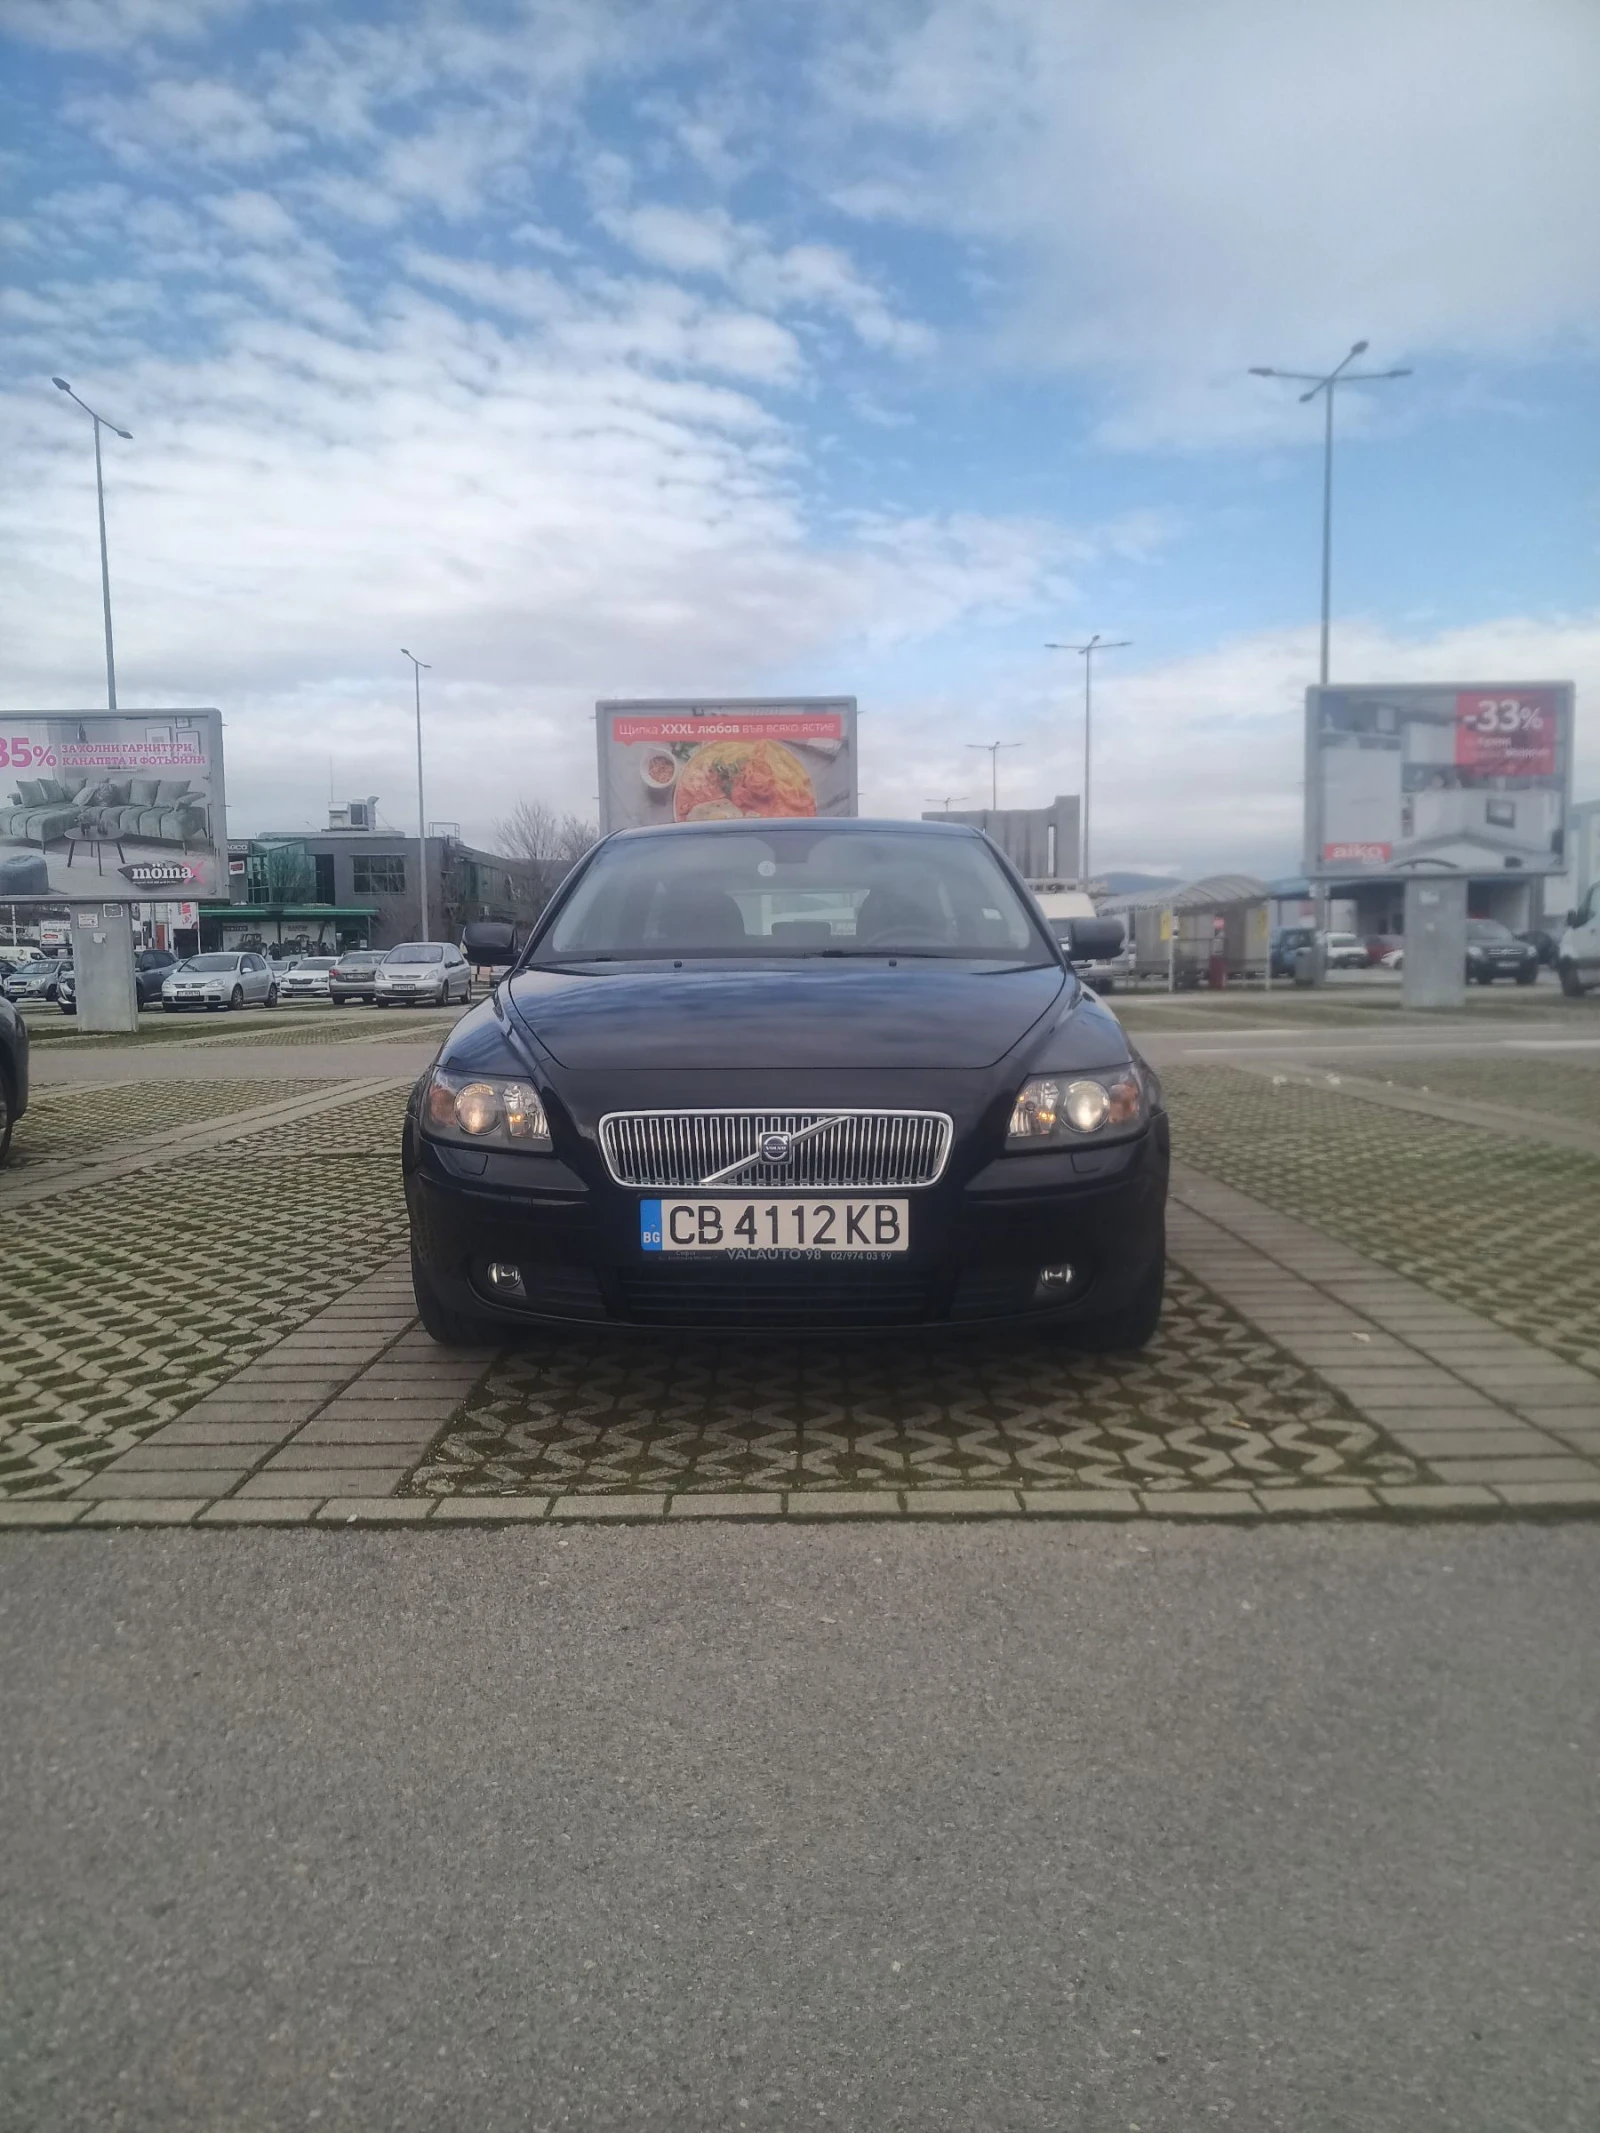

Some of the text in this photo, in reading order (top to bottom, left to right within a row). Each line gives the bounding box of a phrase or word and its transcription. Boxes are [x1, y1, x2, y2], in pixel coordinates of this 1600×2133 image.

[1463, 698, 1544, 731] -33%
[619, 722, 835, 737] Щипка XXXL любов във всяко ястие
[61, 744, 76, 753] ЗА
[77, 744, 119, 753] ХОЛНИ
[62, 755, 206, 766] КАНАПЕТА И ФОТЬОЙЛИ
[643, 1232, 661, 1243] BG
[725, 1247, 802, 1261] VALAUTO
[805, 1247, 822, 1260] 98
[830, 1251, 864, 1261] 02/974
[866, 1251, 878, 1260] 03
[880, 1251, 892, 1260] 99
